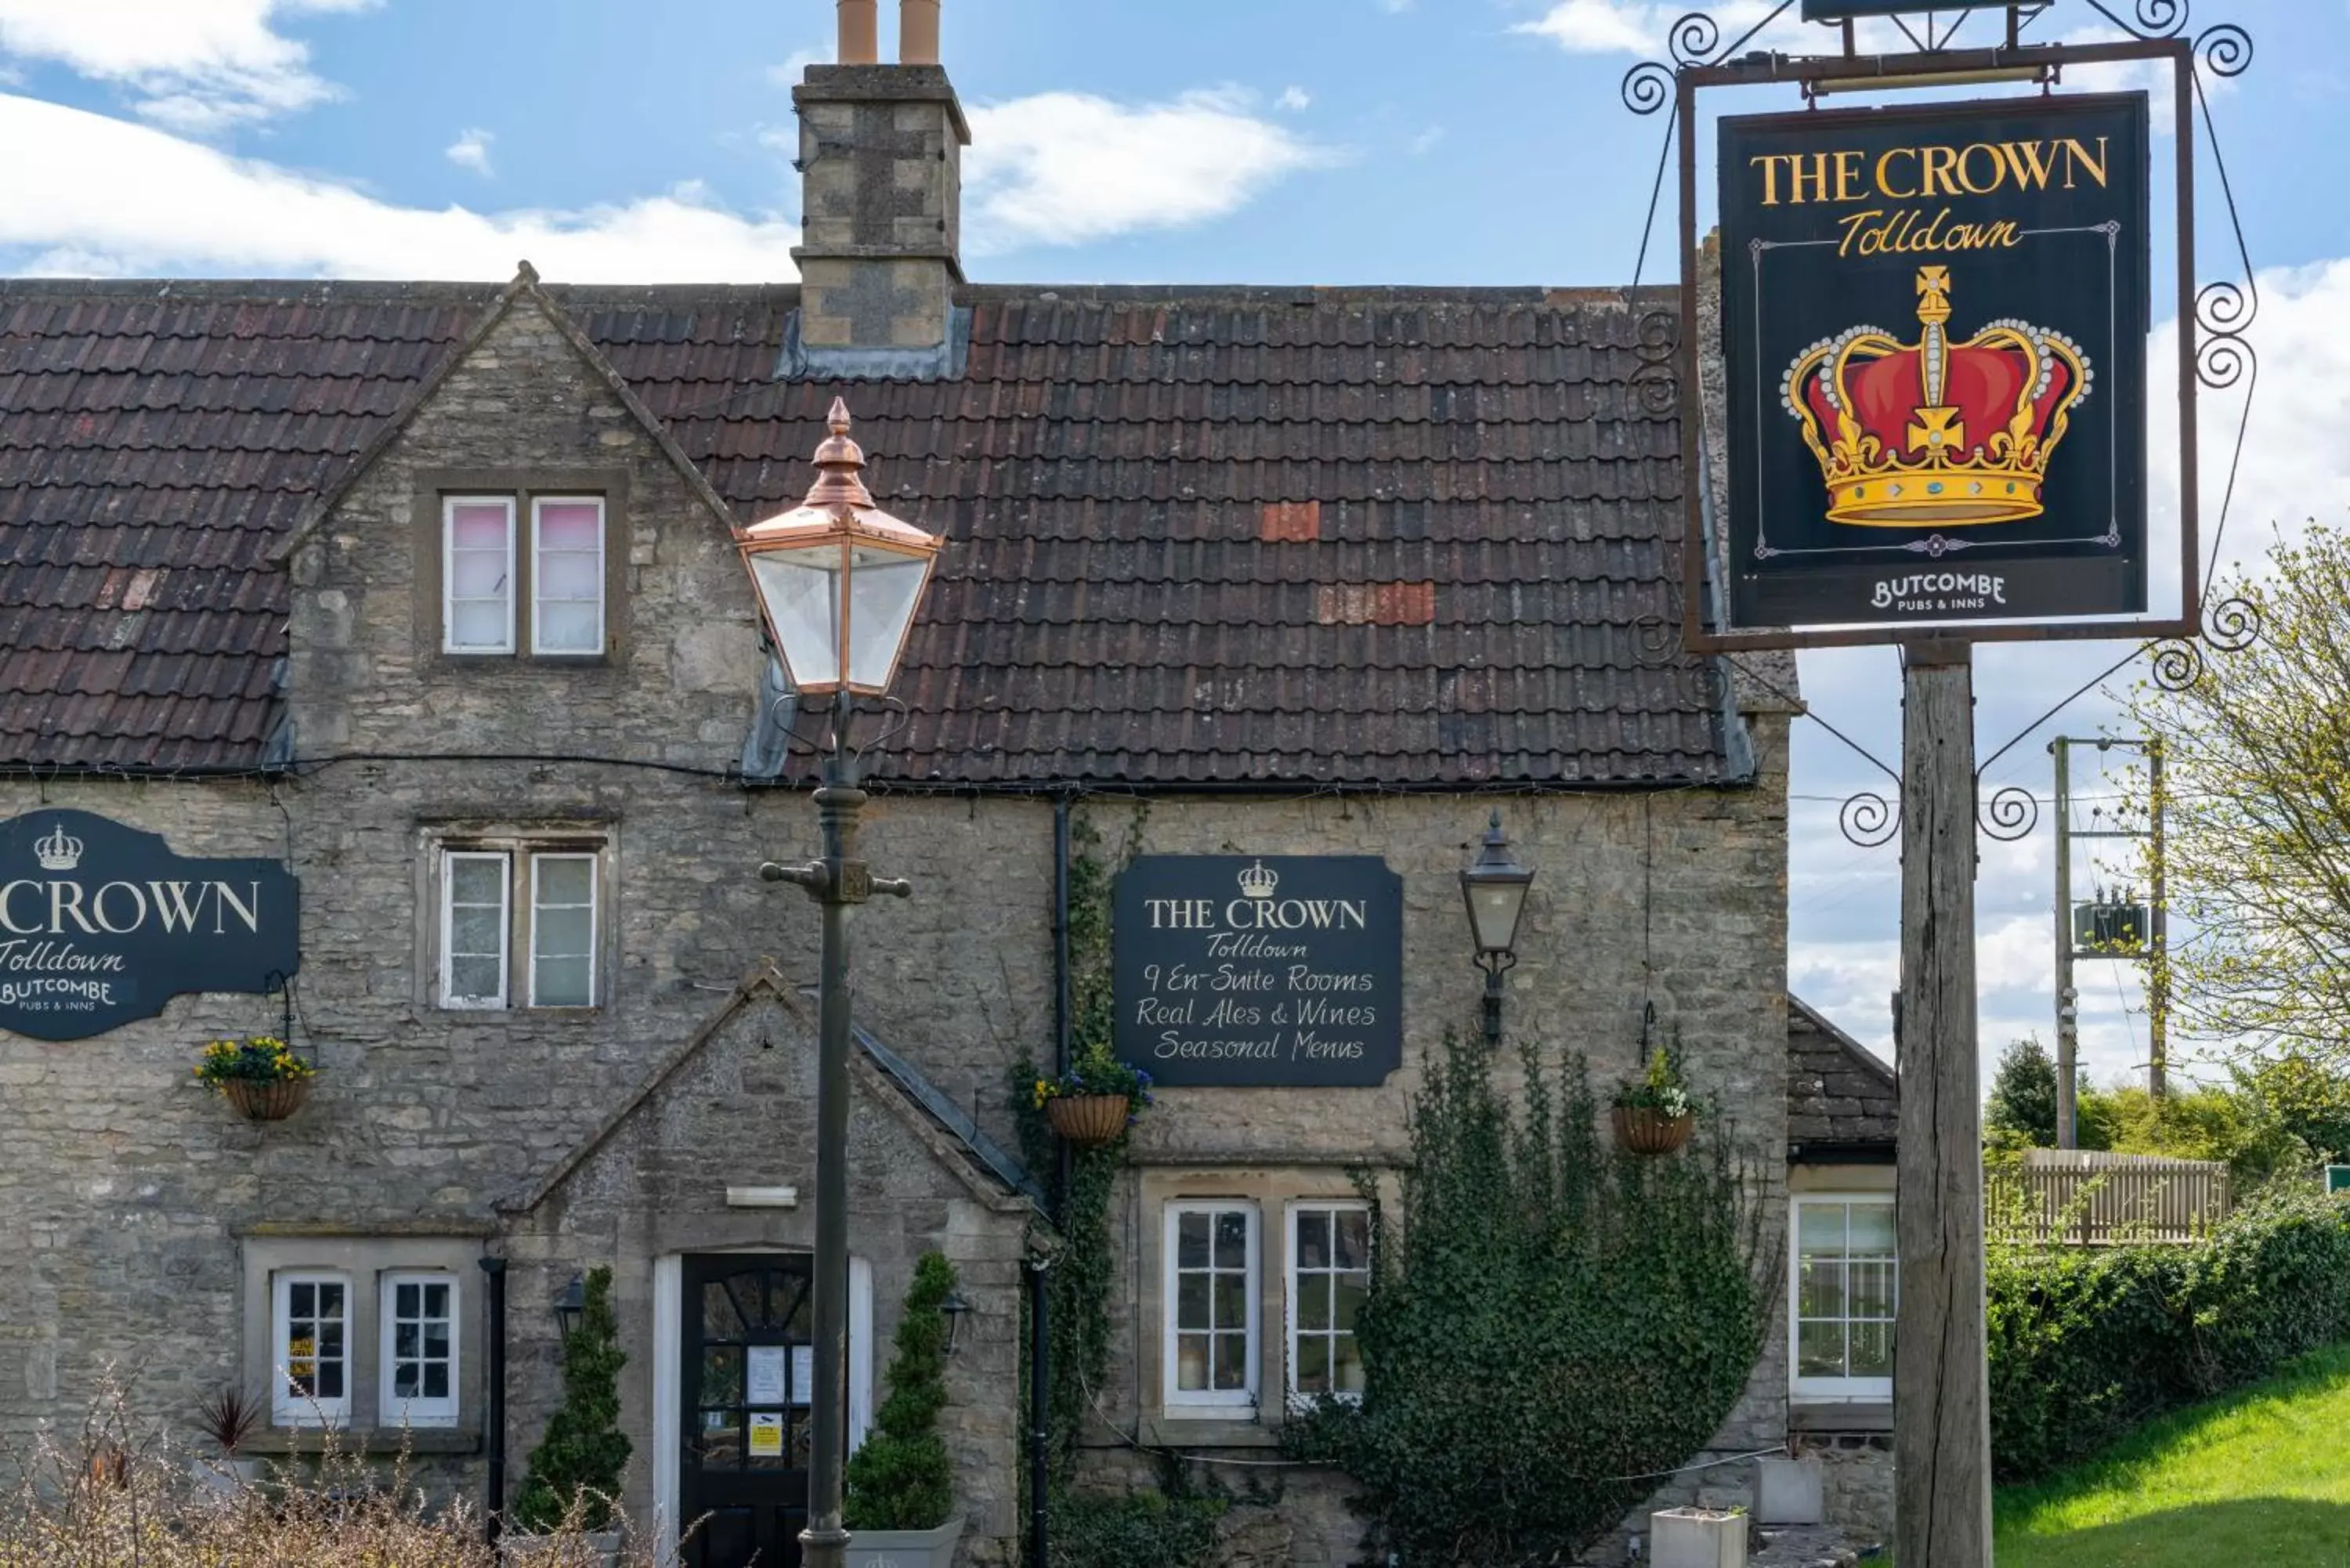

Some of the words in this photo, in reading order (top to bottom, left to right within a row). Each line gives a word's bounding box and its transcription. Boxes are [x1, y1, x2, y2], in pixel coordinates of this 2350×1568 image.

[1750, 151, 1871, 205] THE
[1875, 136, 2109, 199] CROWN
[1838, 208, 2023, 258] Tolldown
[1871, 573, 2006, 609] BUTCOMBE
[1898, 600, 1932, 611] PUBS
[1937, 599, 1947, 609] &
[1951, 598, 1984, 609] INNS
[0, 880, 262, 934] CROWN
[1144, 900, 1215, 928] THE
[1226, 898, 1366, 929] CROWN
[0, 939, 125, 971] Tolldown
[1206, 932, 1307, 958] Tolldown
[0, 979, 116, 1005] BUTCOMBE
[1144, 964, 1159, 992] 9
[1167, 963, 1274, 991] En-Suite
[1288, 965, 1372, 991] Rooms
[19, 1002, 49, 1010] PUBS
[65, 1002, 95, 1010] INNS
[1137, 997, 1194, 1025] Real
[1202, 998, 1260, 1028] Ales
[1271, 1003, 1288, 1024] &
[1297, 997, 1376, 1025] Wines
[1154, 1031, 1281, 1058] Seasonal
[1292, 1031, 1364, 1061] Menus
